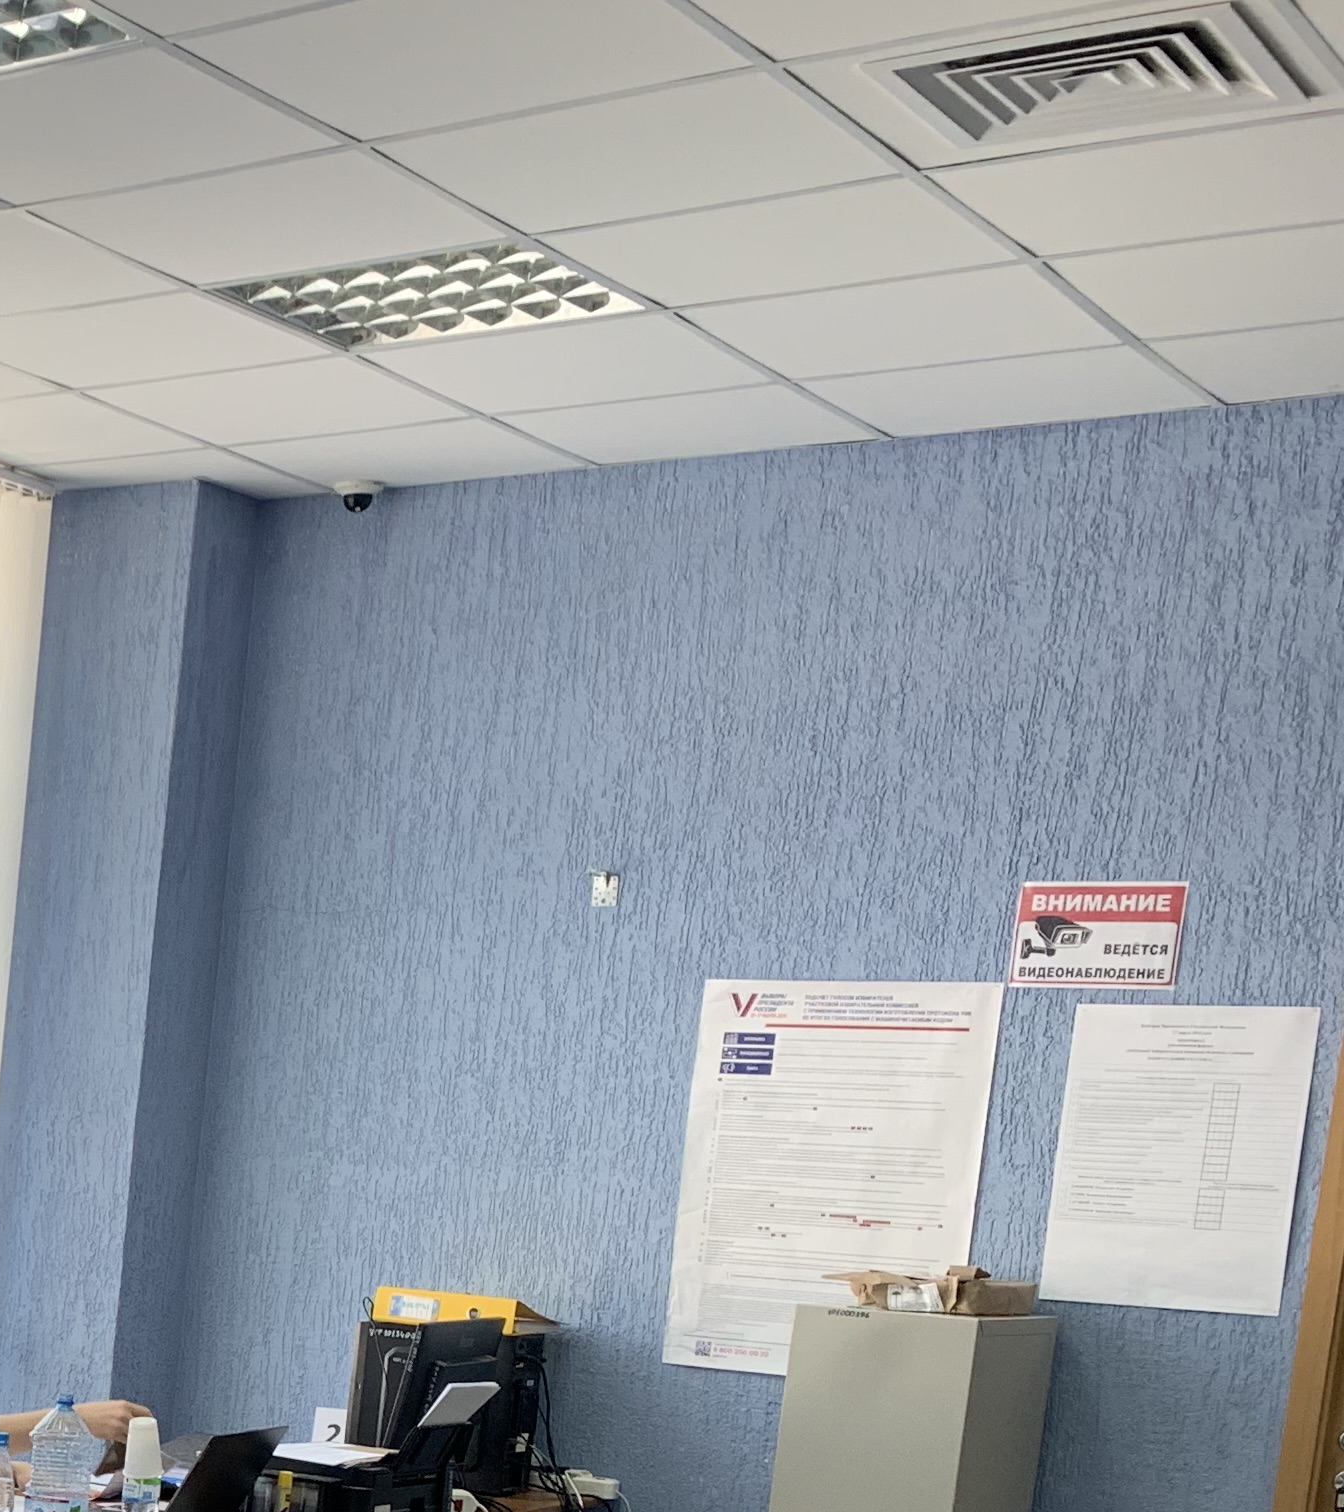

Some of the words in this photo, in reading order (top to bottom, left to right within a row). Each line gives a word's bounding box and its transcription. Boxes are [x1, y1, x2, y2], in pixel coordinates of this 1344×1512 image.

[1031, 894, 1172, 912] ВНИМАНИЕ
[1103, 942, 1168, 956] ВЕДЁТСЯ
[1018, 967, 1165, 979] ВИДЕОНАБЛЮДЕНИЕ
[326, 1424, 341, 1442] 2
